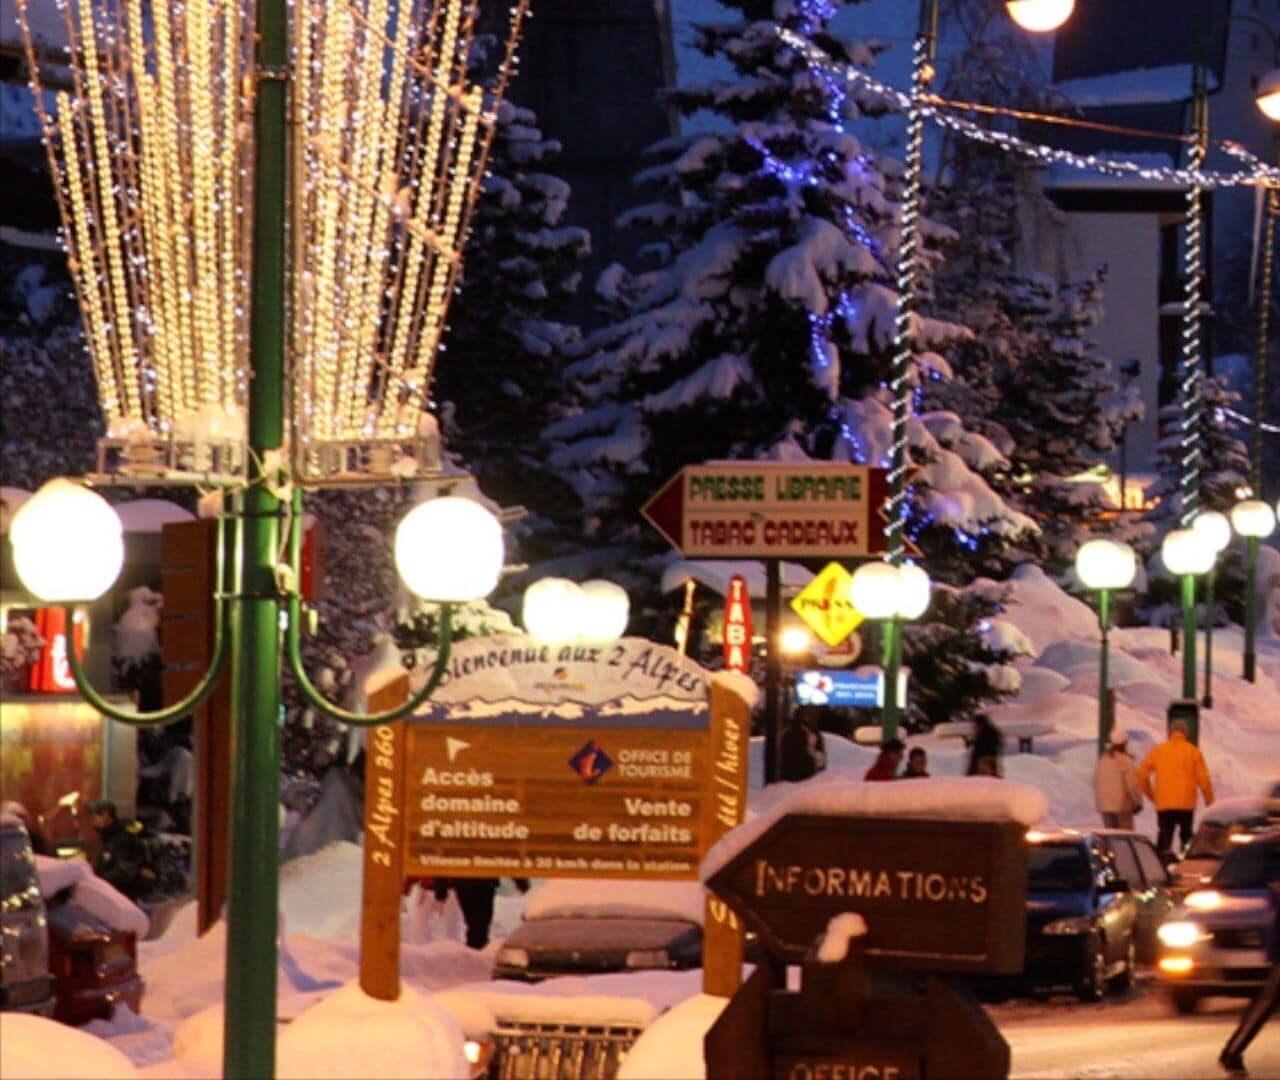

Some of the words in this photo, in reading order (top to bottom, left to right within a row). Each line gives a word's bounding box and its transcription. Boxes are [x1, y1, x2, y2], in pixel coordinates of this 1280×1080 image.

[690, 476, 764, 500] PRESSE
[776, 476, 860, 500] LIBRAIRIE
[690, 521, 756, 545] TABAC
[764, 521, 858, 545] CADEAUX
[727, 580, 746, 673] TABA
[557, 644, 599, 664] aux
[608, 646, 623, 667] 2
[622, 647, 701, 693] Alpes
[618, 750, 668, 763] OFFICE
[673, 751, 692, 763] DE
[421, 768, 494, 786] Accès
[618, 764, 692, 778] TOURISME
[368, 777, 399, 848] Alpes
[420, 794, 520, 813] domaine
[625, 798, 692, 817] Vente
[419, 821, 529, 839] d'altitude
[573, 824, 602, 840] de
[608, 823, 692, 843] forfaits
[372, 851, 391, 867] 2
[755, 860, 987, 903] INFORMATIONS
